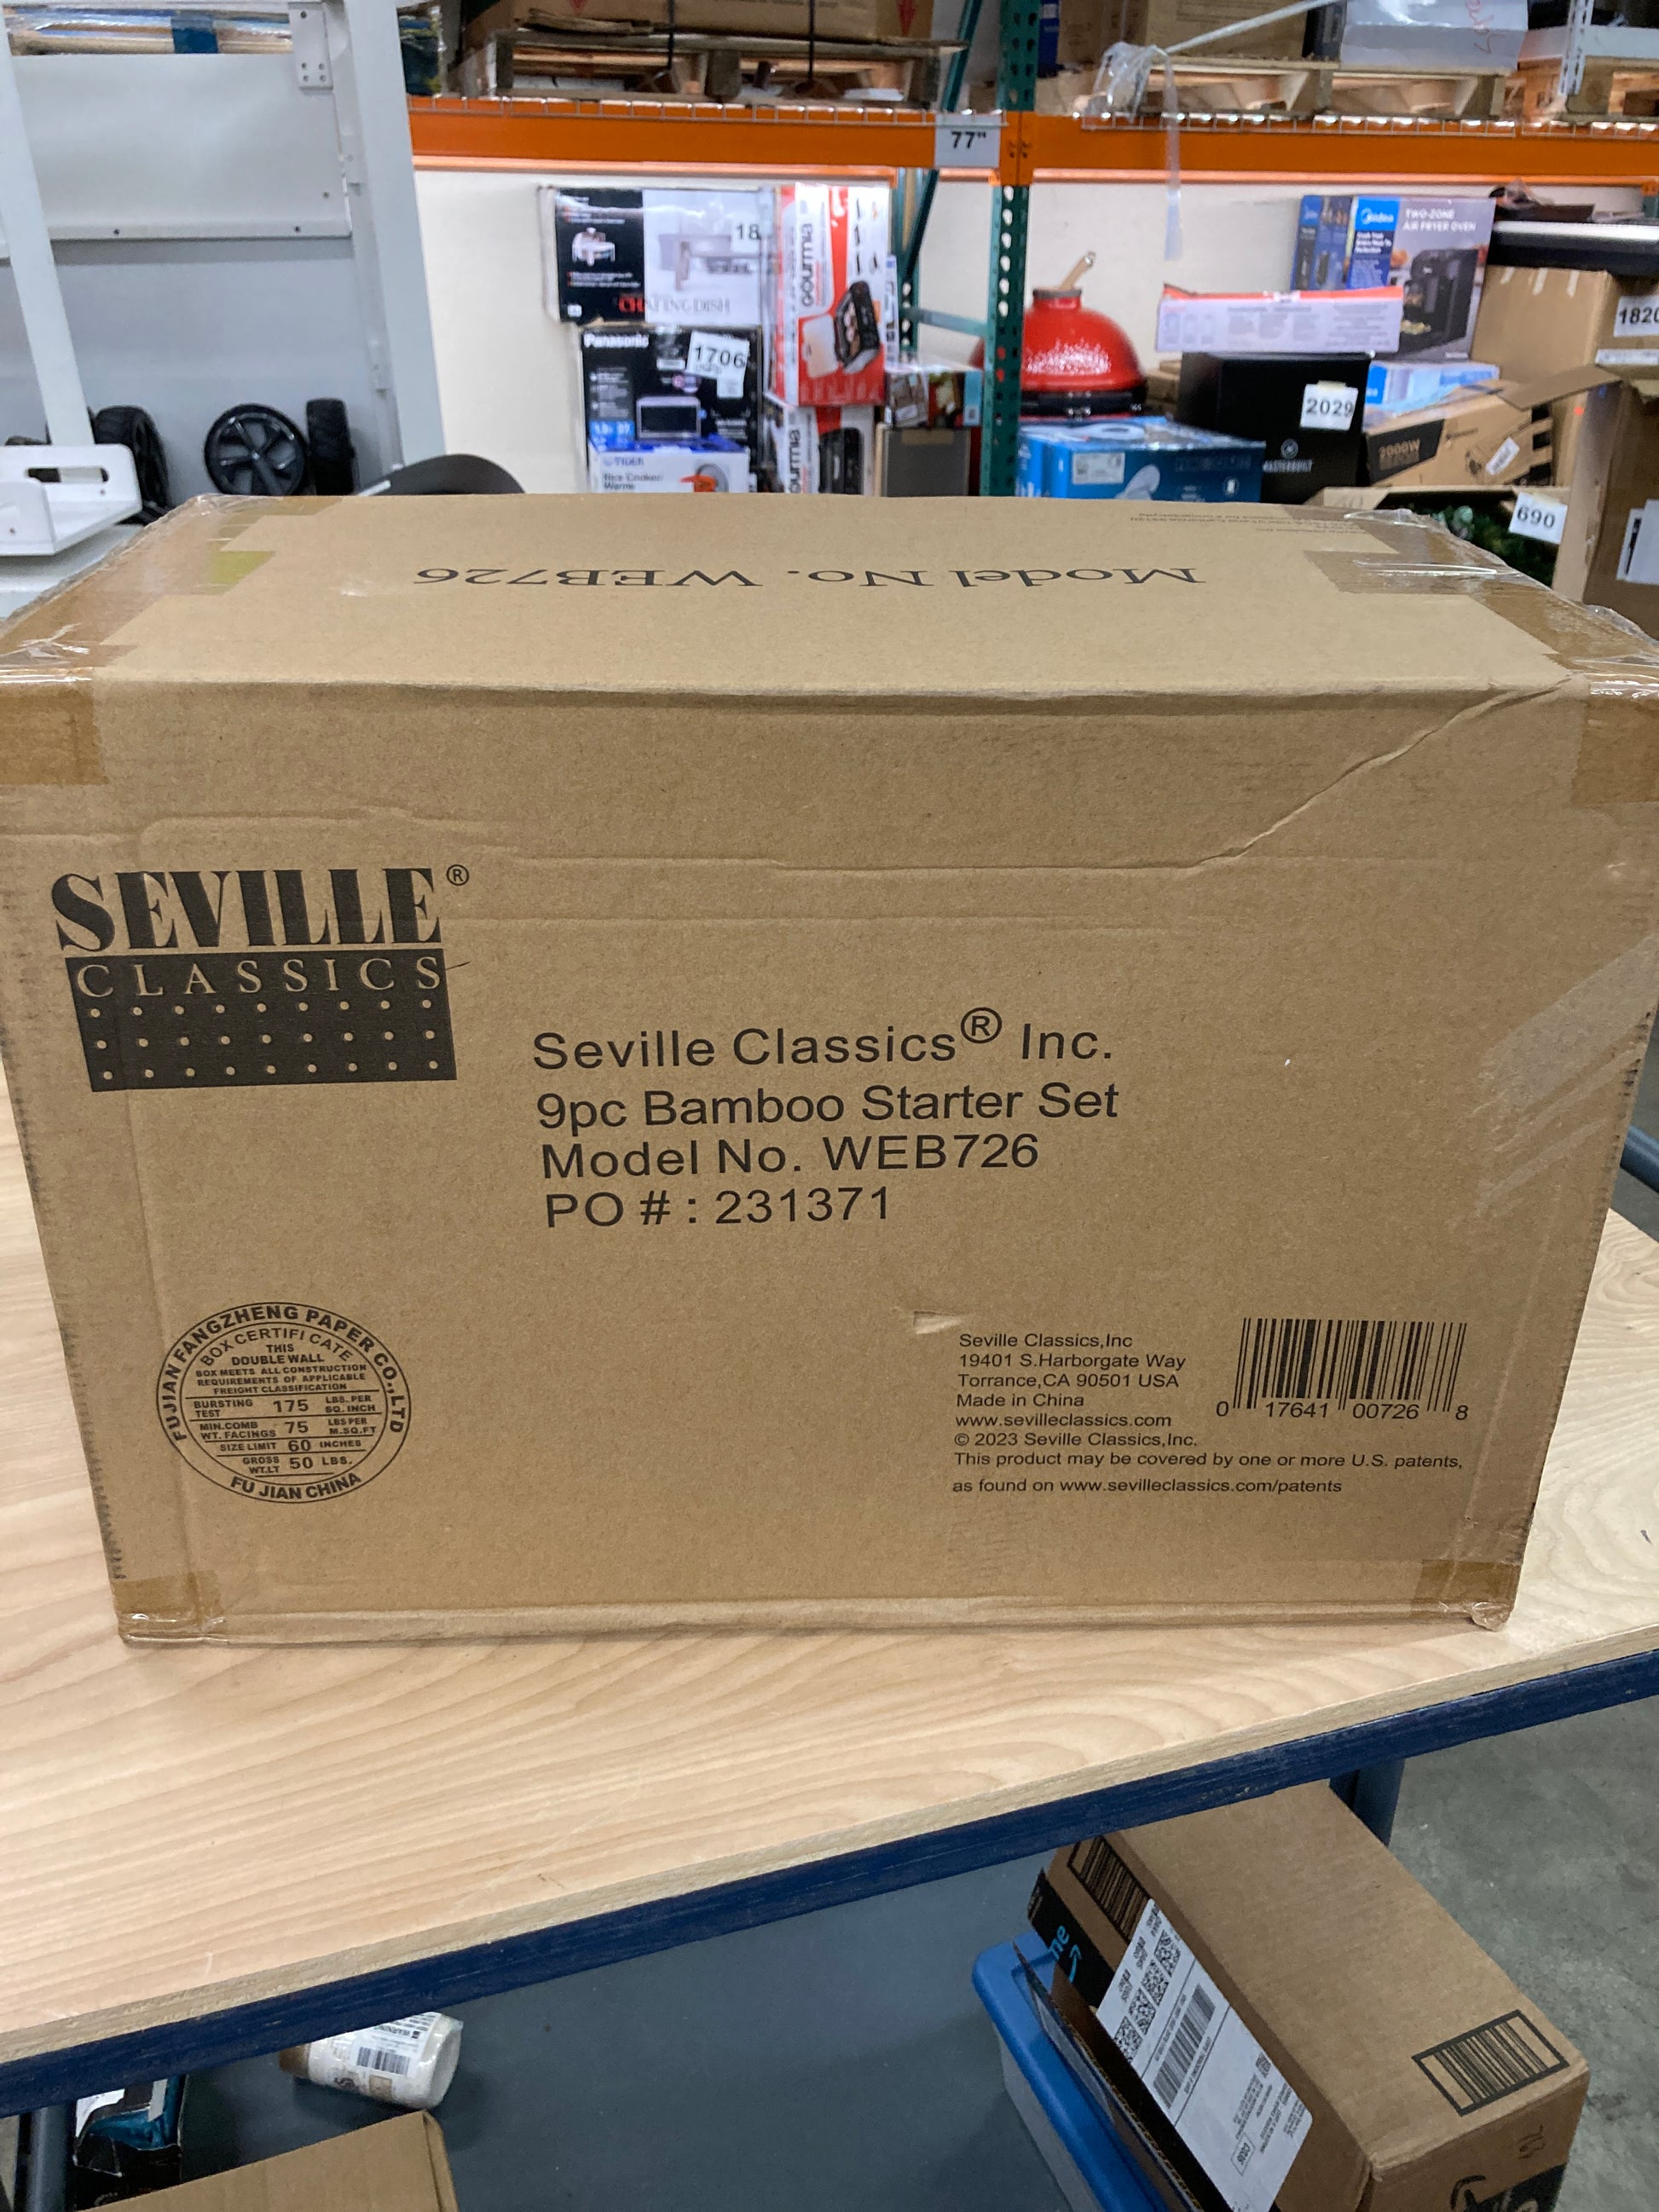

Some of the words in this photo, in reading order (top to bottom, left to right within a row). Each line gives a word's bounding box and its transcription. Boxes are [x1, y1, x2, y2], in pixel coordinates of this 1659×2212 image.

[951, 131, 986, 148] 77"
[584, 332, 649, 349] Panasonic
[695, 345, 745, 368] 1706
[1306, 397, 1352, 417] 2029
[1517, 505, 1556, 528] 690
[416, 569, 763, 586] WEB726
[787, 569, 935, 586] No.
[956, 566, 1207, 587] Model
[77, 956, 442, 997] CLASSICS
[533, 1030, 717, 1071] Seville
[1021, 1023, 1113, 1060] Inc.
[537, 1092, 627, 1136] 9pc
[645, 1089, 845, 1125] Bamboo
[863, 1084, 1022, 1120] Starter
[1039, 1083, 1119, 1118] Set
[543, 1140, 698, 1179] Model
[719, 1138, 802, 1173] No.
[823, 1134, 1039, 1170] WEB726
[546, 1193, 623, 1227] PO
[715, 1187, 888, 1223] 231371
[174, 1305, 299, 1362] FANGZHENG
[306, 1310, 374, 1352] PAPER
[266, 1344, 294, 1353] THIS
[960, 1333, 1018, 1347] Seville
[200, 1341, 234, 1366] BOX
[232, 1355, 284, 1366] DOUBLE
[288, 1354, 325, 1362] WALL
[283, 1365, 367, 1373] CONSTRUCTION
[959, 1354, 1012, 1367] 19401
[1146, 1354, 1186, 1371] Way
[197, 1377, 279, 1386] REQUIREMENTS
[214, 1386, 259, 1395] FREIGHT
[261, 1383, 347, 1393] CLASSIFICATION
[1077, 1374, 1130, 1387] 90501
[1139, 1374, 1179, 1388] USA
[162, 1364, 188, 1441] FUJIAN
[194, 1399, 253, 1409] BURSTING
[273, 1400, 309, 1412] 175
[957, 1394, 1005, 1407] Made
[1013, 1394, 1026, 1406] in
[1033, 1394, 1084, 1406] China
[195, 1409, 220, 1418] TEST
[1217, 1401, 1228, 1416] 0
[1266, 1402, 1328, 1418] 17641
[1353, 1404, 1419, 1419] 00726
[1455, 1405, 1468, 1420] 8
[285, 1421, 309, 1434] 75
[956, 1414, 1171, 1427] www.sevilleclassics.com
[225, 1429, 277, 1439] FACINGS
[974, 1434, 1018, 1446] 2023
[1025, 1433, 1082, 1446] Seville
[288, 1440, 311, 1452] 60
[320, 1440, 361, 1448] INCHES
[289, 1457, 314, 1469] 50
[322, 1457, 352, 1465] LBS.
[955, 1453, 990, 1465] This
[997, 1453, 1061, 1467] product
[1068, 1454, 1104, 1467] may
[1111, 1453, 1131, 1464] be
[1137, 1453, 1206, 1465] covered
[1213, 1453, 1233, 1468] by
[1240, 1454, 1271, 1466] one
[1278, 1455, 1296, 1466] or
[1301, 1455, 1344, 1466] more
[1352, 1454, 1388, 1467] U.S.
[1395, 1455, 1463, 1470] patents,
[230, 1476, 255, 1493] FU
[259, 1484, 302, 1499] JIAN
[306, 1473, 361, 1499] CHINA
[953, 1481, 973, 1492] as
[980, 1479, 1026, 1492] found
[1032, 1481, 1054, 1492] on
[1060, 1479, 1342, 1494] www.sevilleclassics.com/patents
